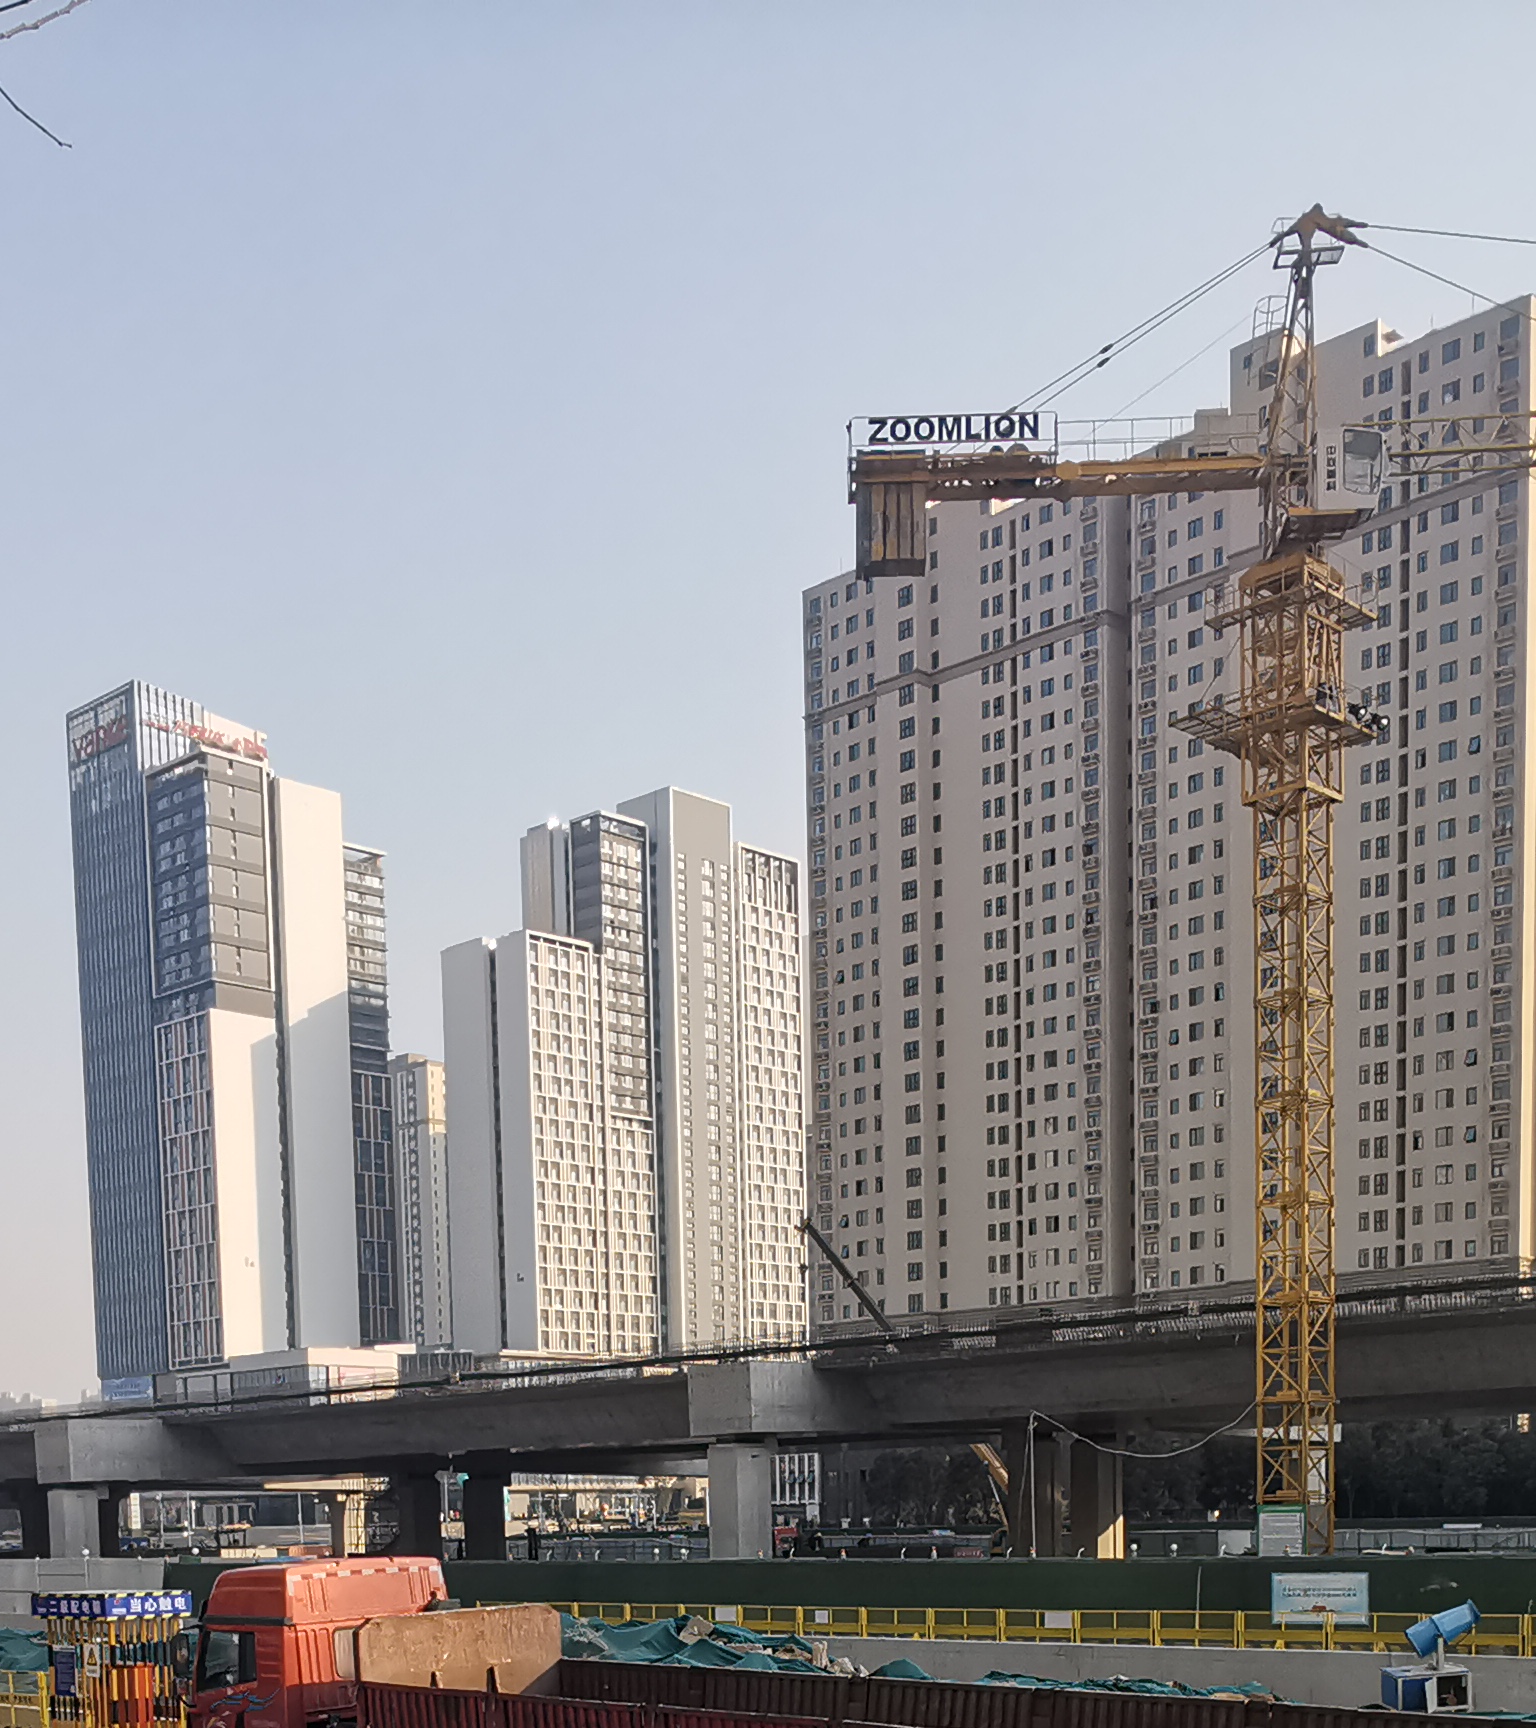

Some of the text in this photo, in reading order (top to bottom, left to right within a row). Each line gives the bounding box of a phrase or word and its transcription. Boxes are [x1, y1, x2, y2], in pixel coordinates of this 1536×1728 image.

[868, 413, 1039, 443] ZOOMLION
[129, 1596, 188, 1613] 当心触电
